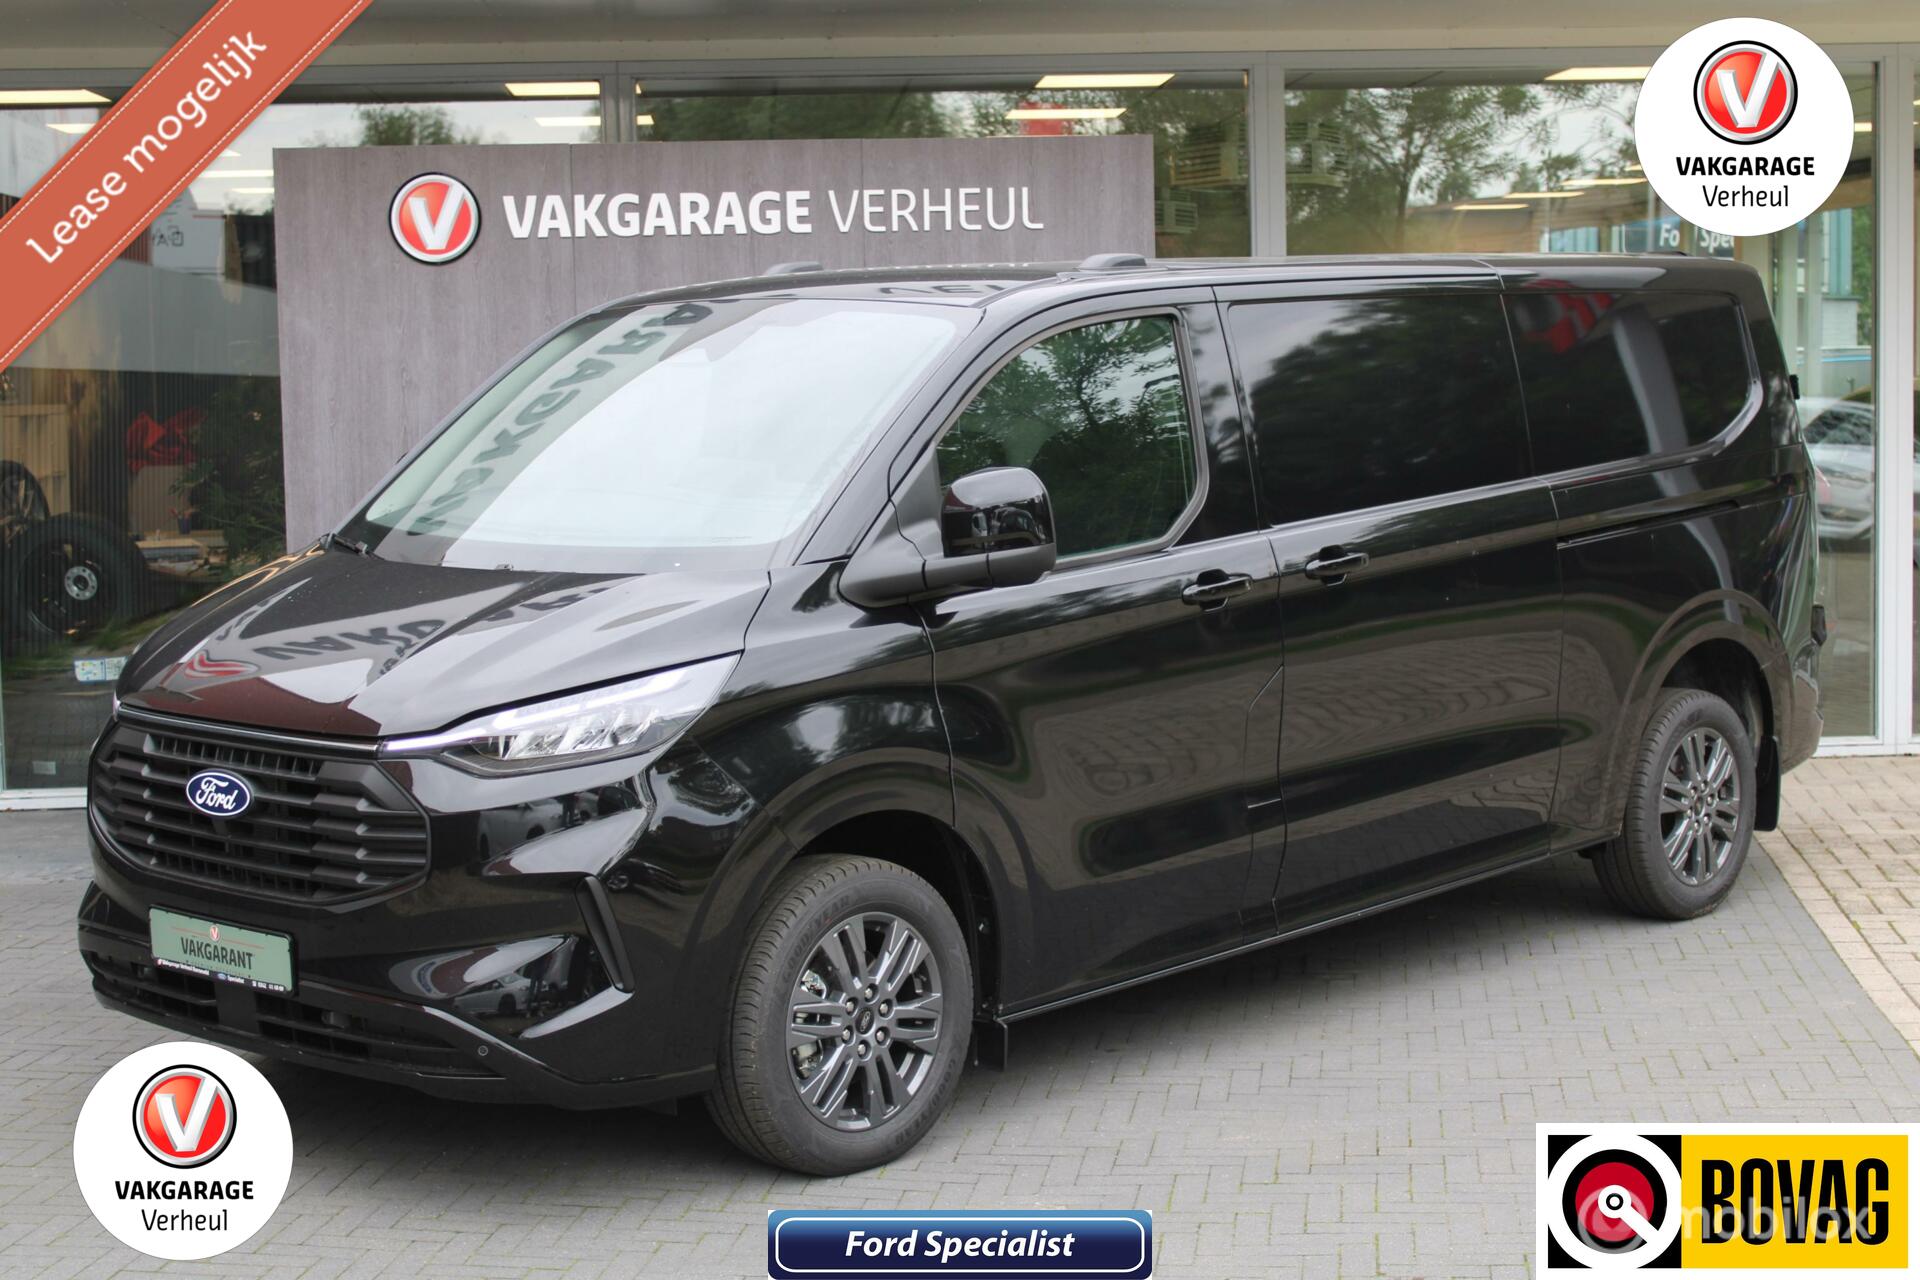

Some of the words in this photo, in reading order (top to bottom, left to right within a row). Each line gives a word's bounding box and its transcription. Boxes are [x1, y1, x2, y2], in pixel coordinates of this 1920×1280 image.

[408, 182, 465, 251] V
[503, 190, 812, 238] VAKGARAGE
[828, 187, 1044, 233] VERHEUL
[196, 777, 238, 810] Ford
[180, 936, 253, 969] VAKGARANT
